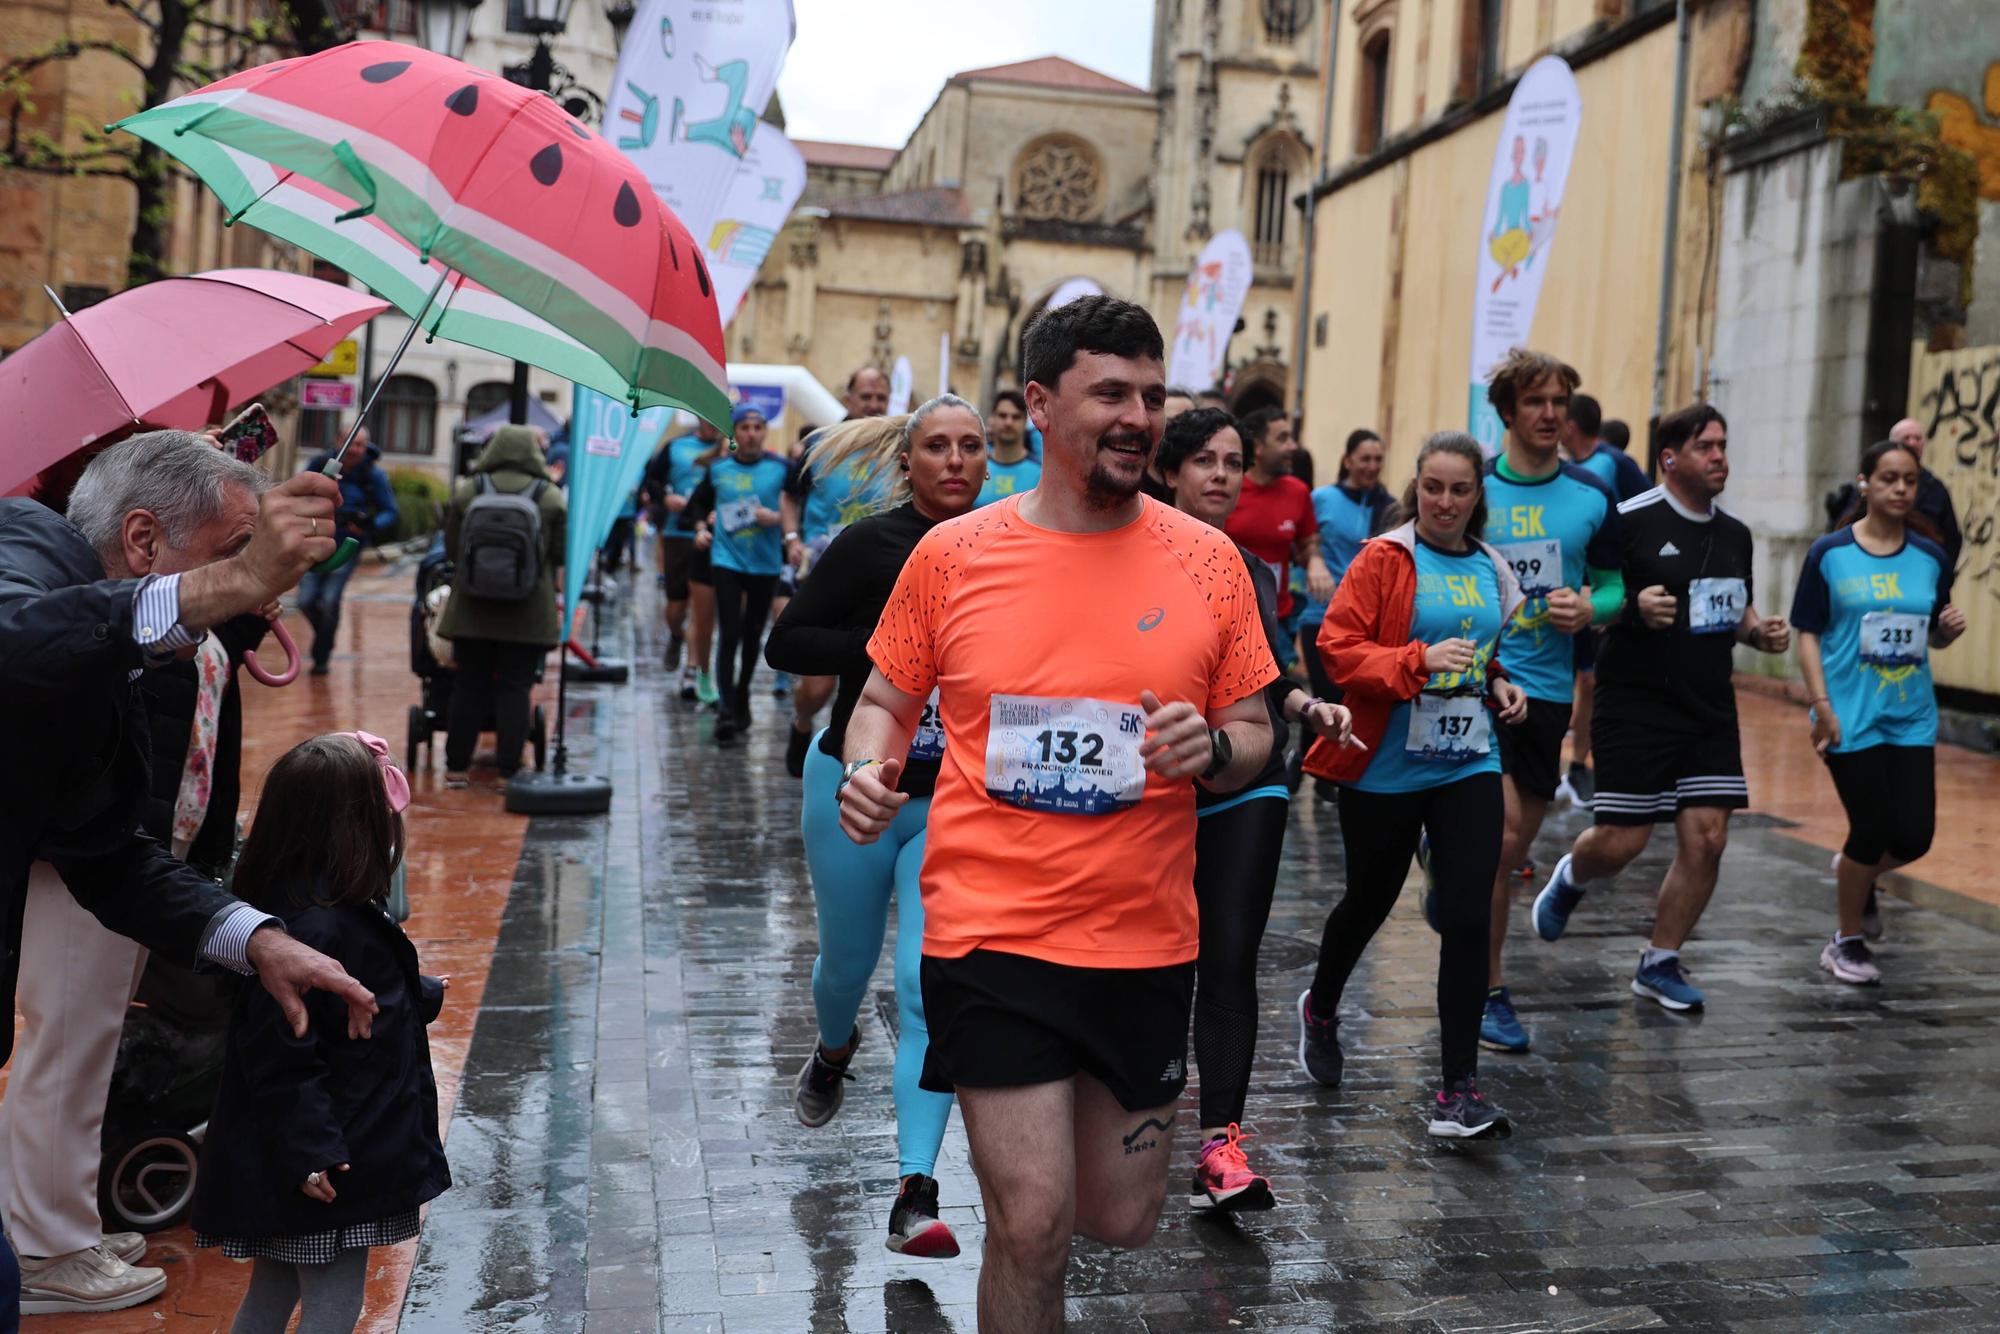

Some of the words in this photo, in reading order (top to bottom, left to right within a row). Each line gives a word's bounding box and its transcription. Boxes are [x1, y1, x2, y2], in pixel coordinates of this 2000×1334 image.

[1511, 505, 1546, 537] 5K
[1508, 559, 1541, 576] 99
[1446, 575, 1485, 608] 5K
[1871, 572, 1904, 600] 5K
[1710, 594, 1733, 610] 194
[1880, 628, 1912, 644] 233
[1000, 718, 1040, 727] SEGURIDAD
[1120, 712, 1139, 734] 5K
[1438, 715, 1473, 736] 137
[1036, 730, 1104, 767] 132
[1021, 762, 1077, 774] FRANCISCO
[1079, 767, 1114, 777] JAVIER
